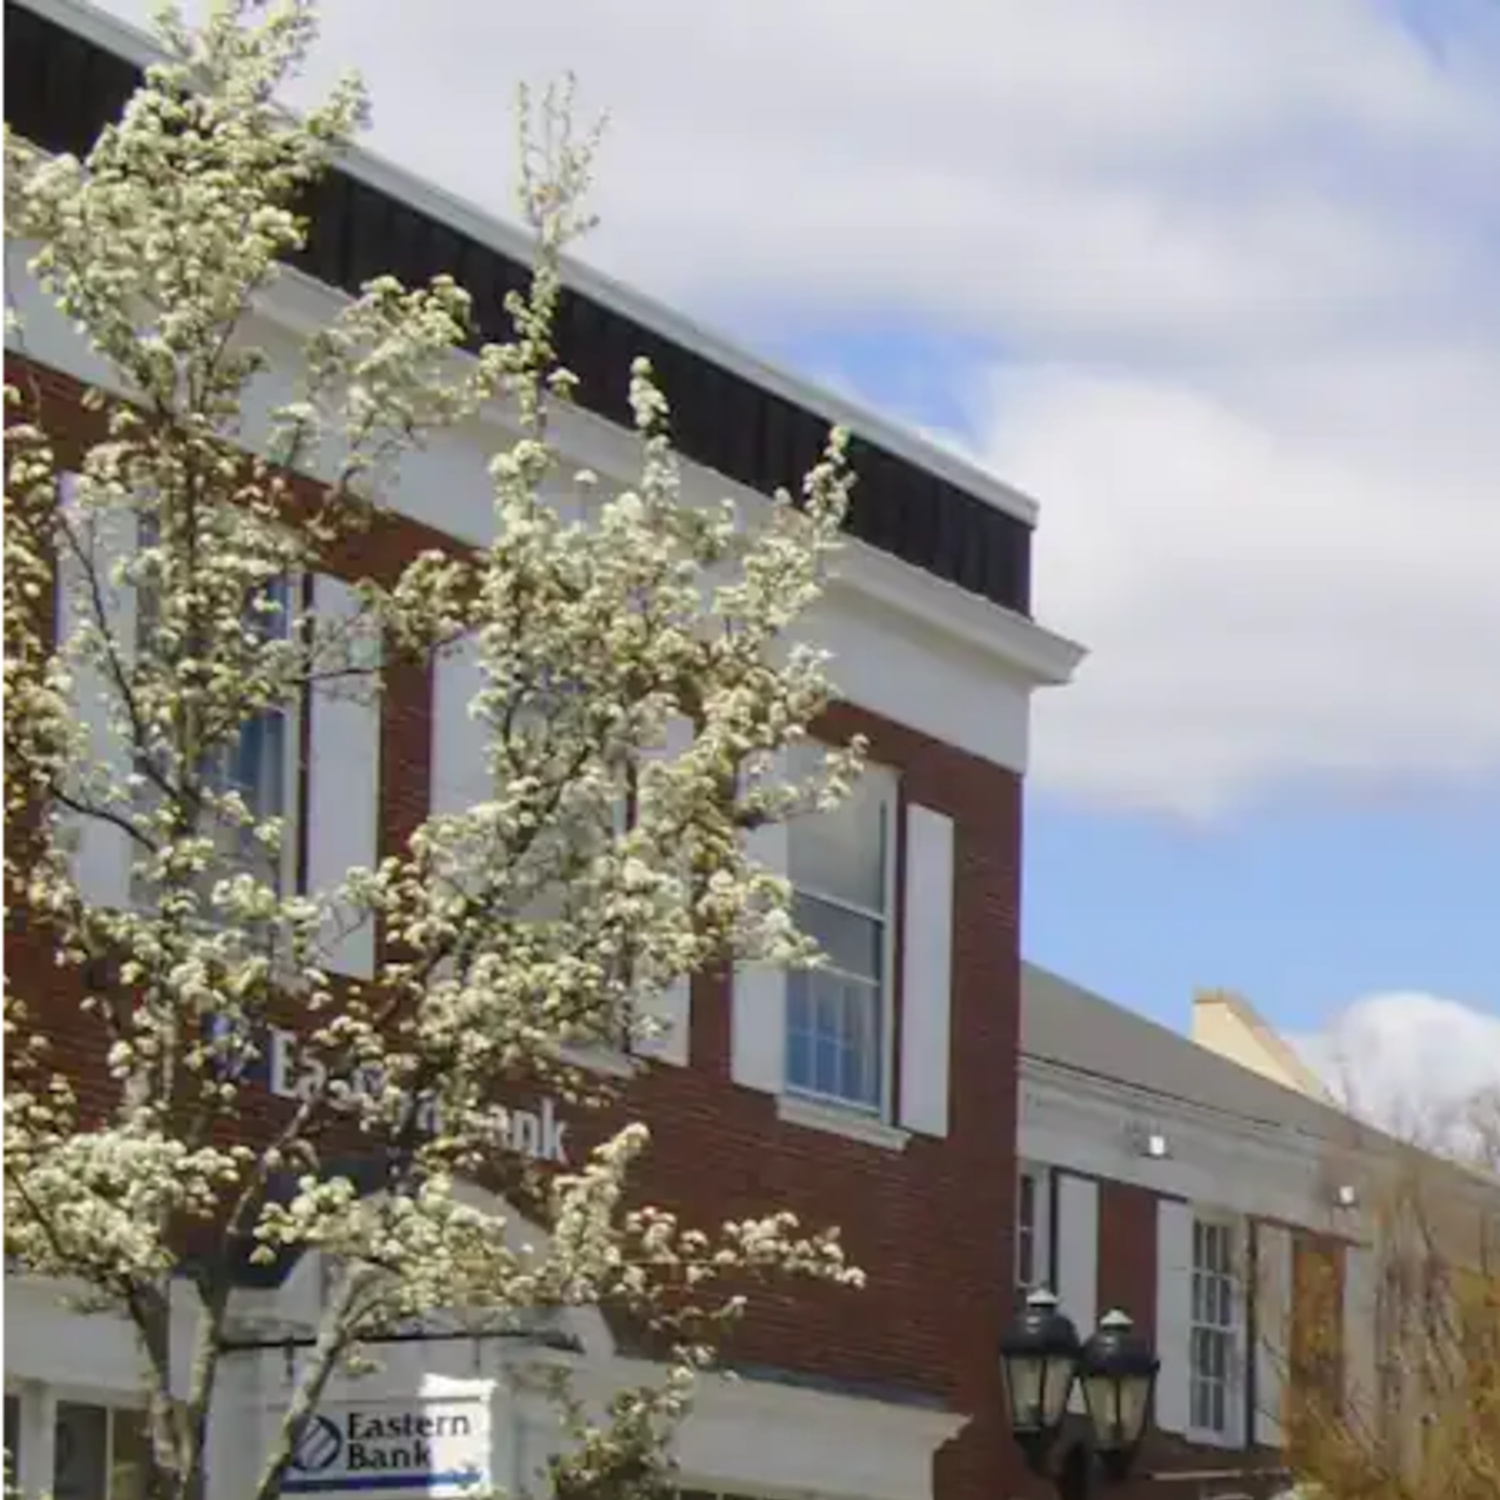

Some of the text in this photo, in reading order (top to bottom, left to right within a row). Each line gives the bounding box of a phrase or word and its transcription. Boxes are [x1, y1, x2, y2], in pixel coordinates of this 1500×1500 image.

[482, 1096, 567, 1167] ank
[346, 1411, 472, 1440] Eastern
[346, 1442, 432, 1471] Bank
